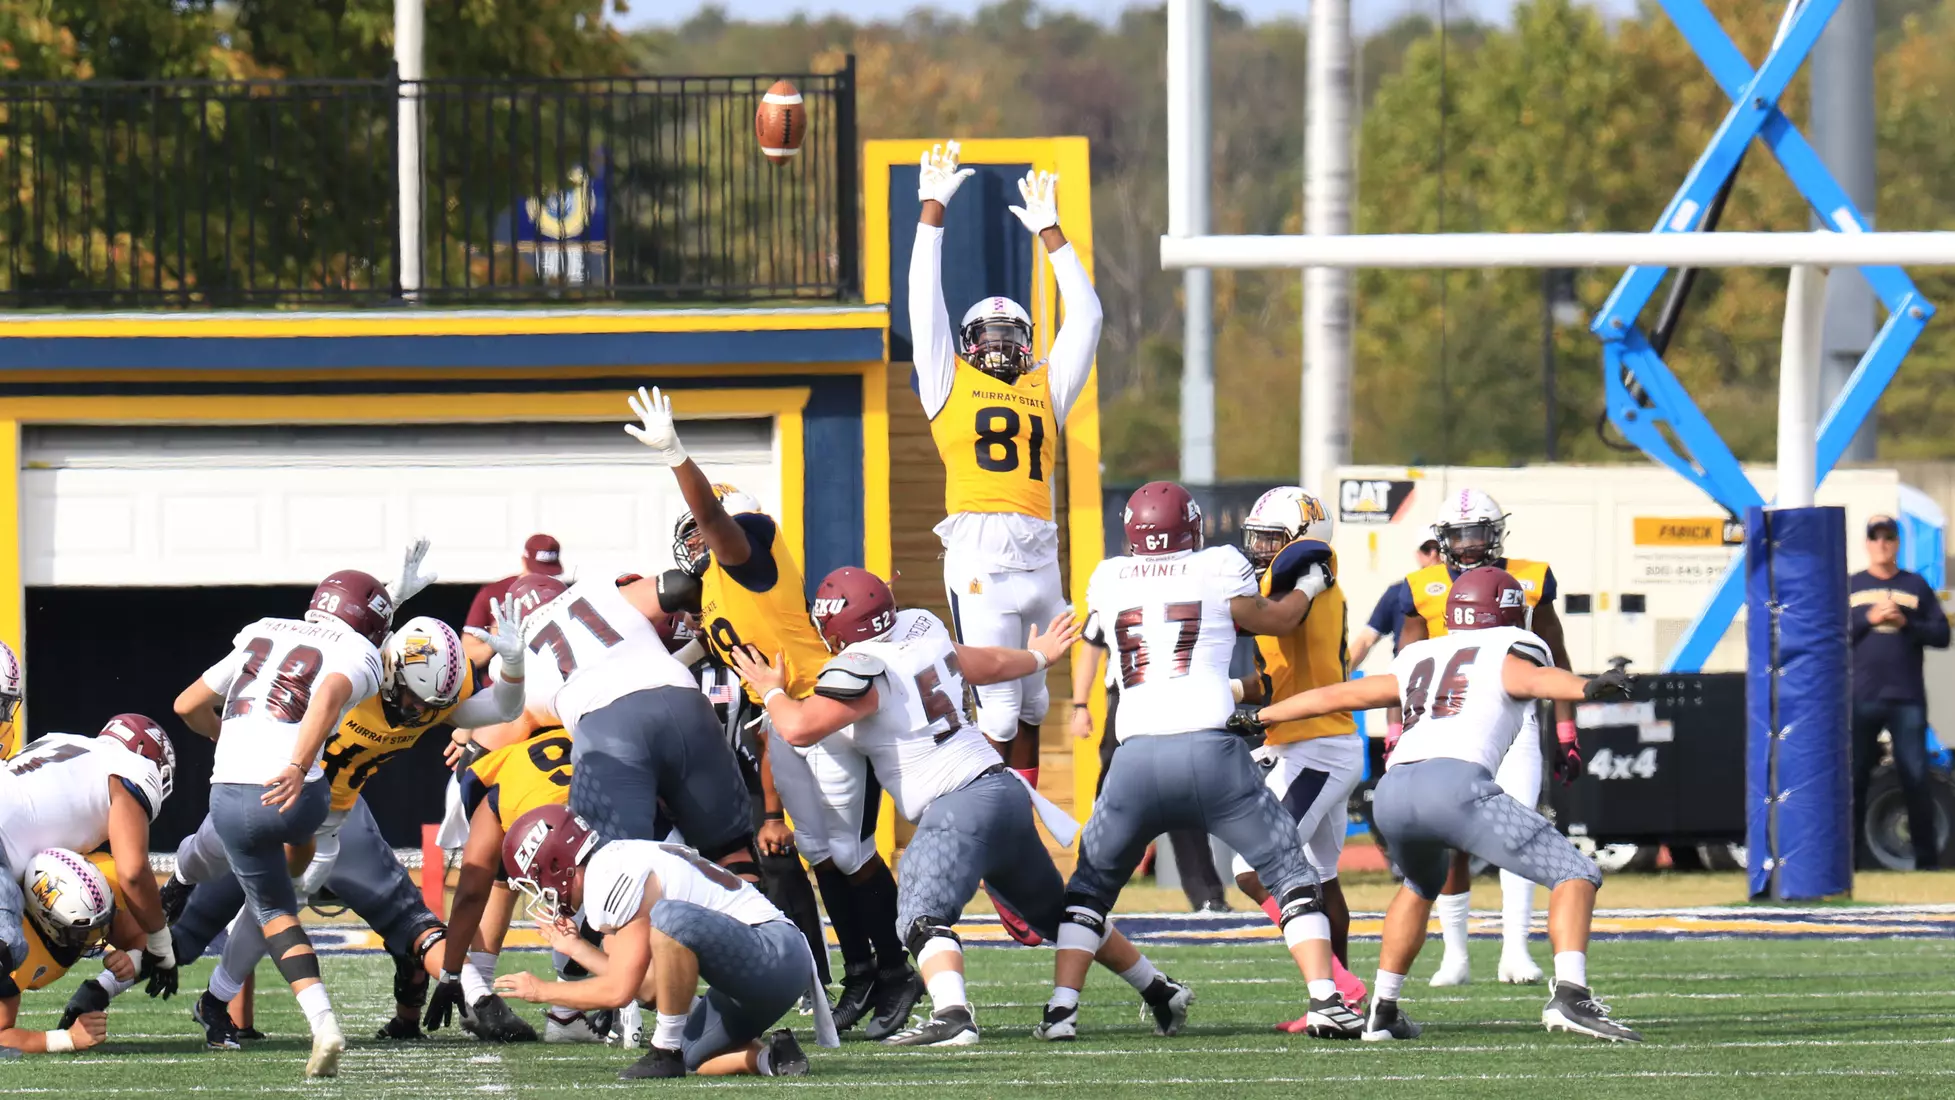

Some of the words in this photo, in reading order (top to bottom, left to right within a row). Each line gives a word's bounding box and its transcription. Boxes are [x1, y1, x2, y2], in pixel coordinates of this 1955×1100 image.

[972, 390, 1018, 402] MURRAY
[1018, 396, 1046, 409] STATE
[974, 406, 1044, 482] 81
[1342, 481, 1392, 512] CAT
[316, 592, 340, 612] 28
[814, 598, 846, 616] EKU
[1453, 607, 1475, 625] 86
[871, 611, 891, 632] 52
[528, 596, 625, 682] 71
[1114, 600, 1202, 690] 67
[221, 637, 323, 724] 28
[1402, 646, 1481, 734] 86
[346, 720, 388, 743] MURRAY
[1587, 747, 1658, 780] 4x4
[514, 818, 549, 875] EKU
